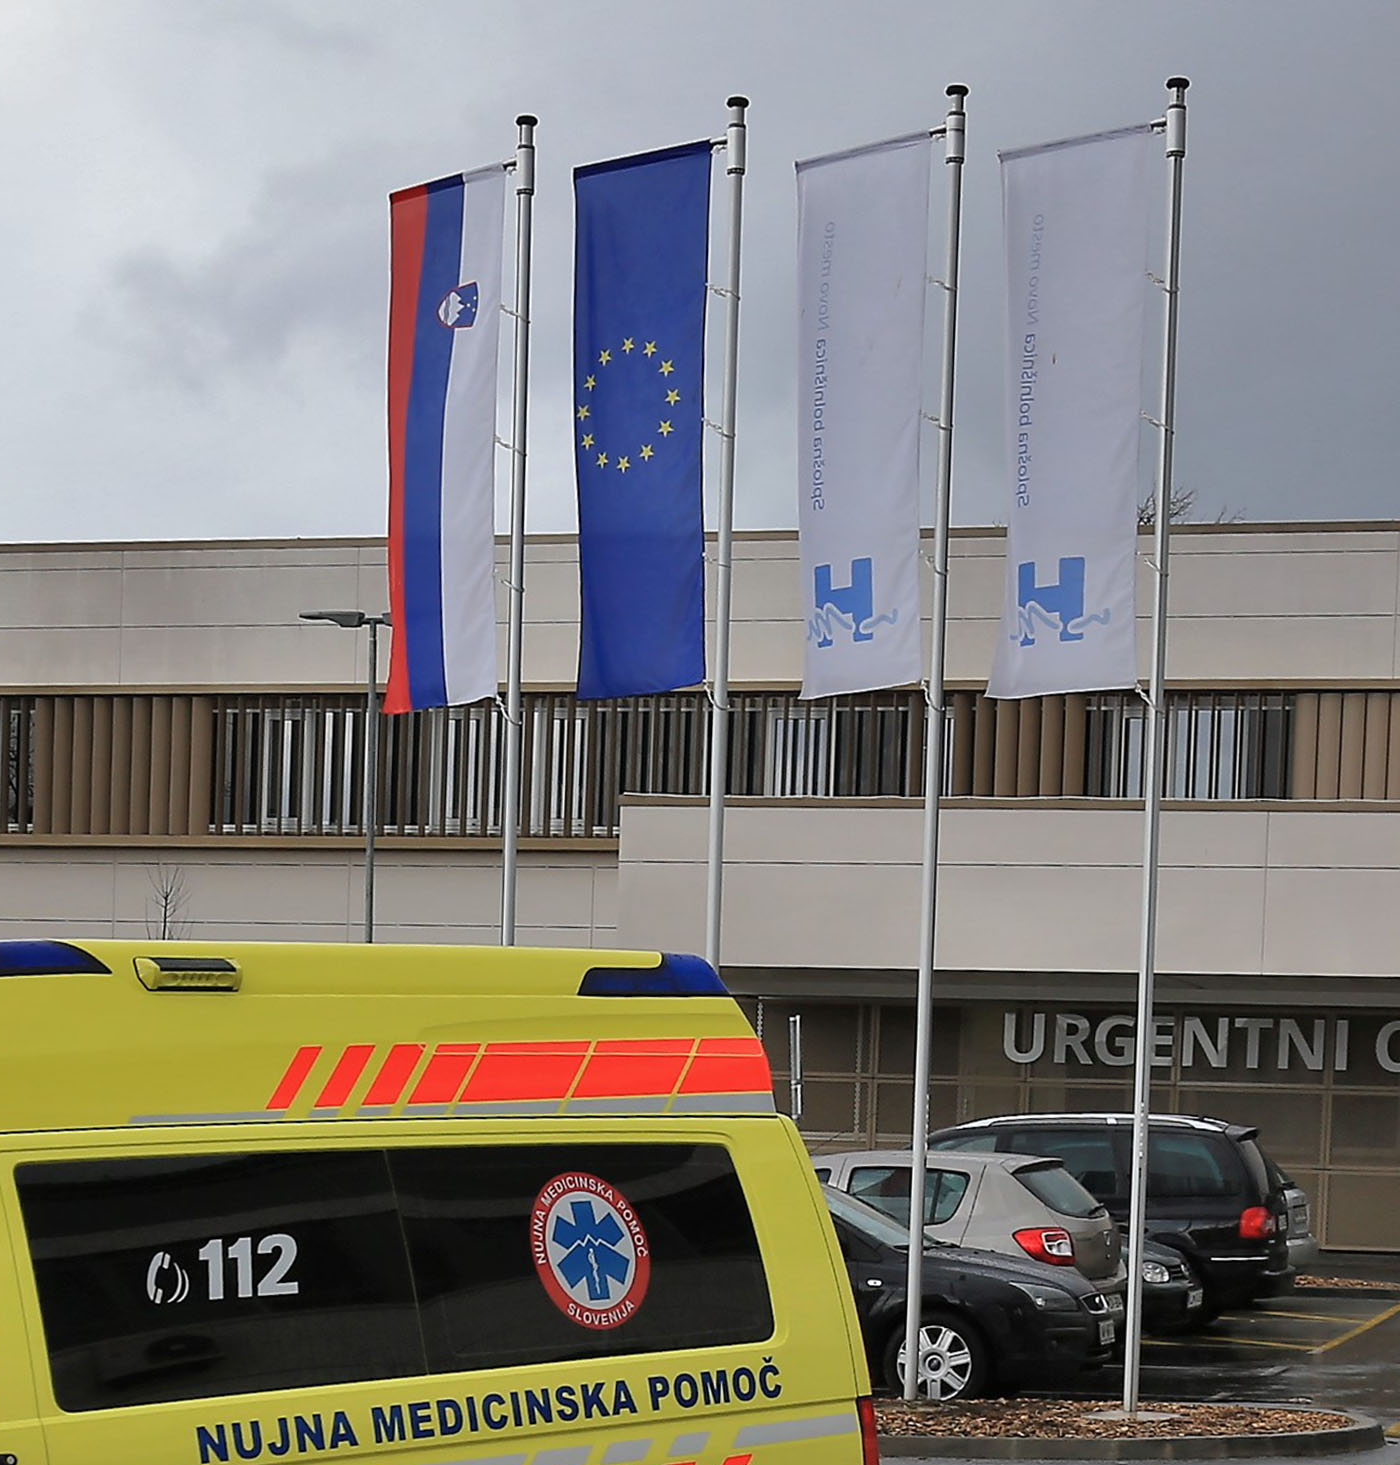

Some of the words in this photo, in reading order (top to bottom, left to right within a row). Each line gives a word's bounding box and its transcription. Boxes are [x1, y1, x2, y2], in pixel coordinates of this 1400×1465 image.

[1003, 1012, 1350, 1072] URGENTNI
[540, 1175, 614, 1208] MEDICINSKA
[533, 1209, 548, 1265] NUJNA
[616, 1199, 649, 1257] POMOČ
[198, 1233, 299, 1301] 112
[566, 1300, 635, 1326] SLOVENIJA
[196, 1410, 359, 1464] NUJNA
[371, 1379, 638, 1444] MEDICINSKA
[647, 1356, 782, 1411] POMOČ
